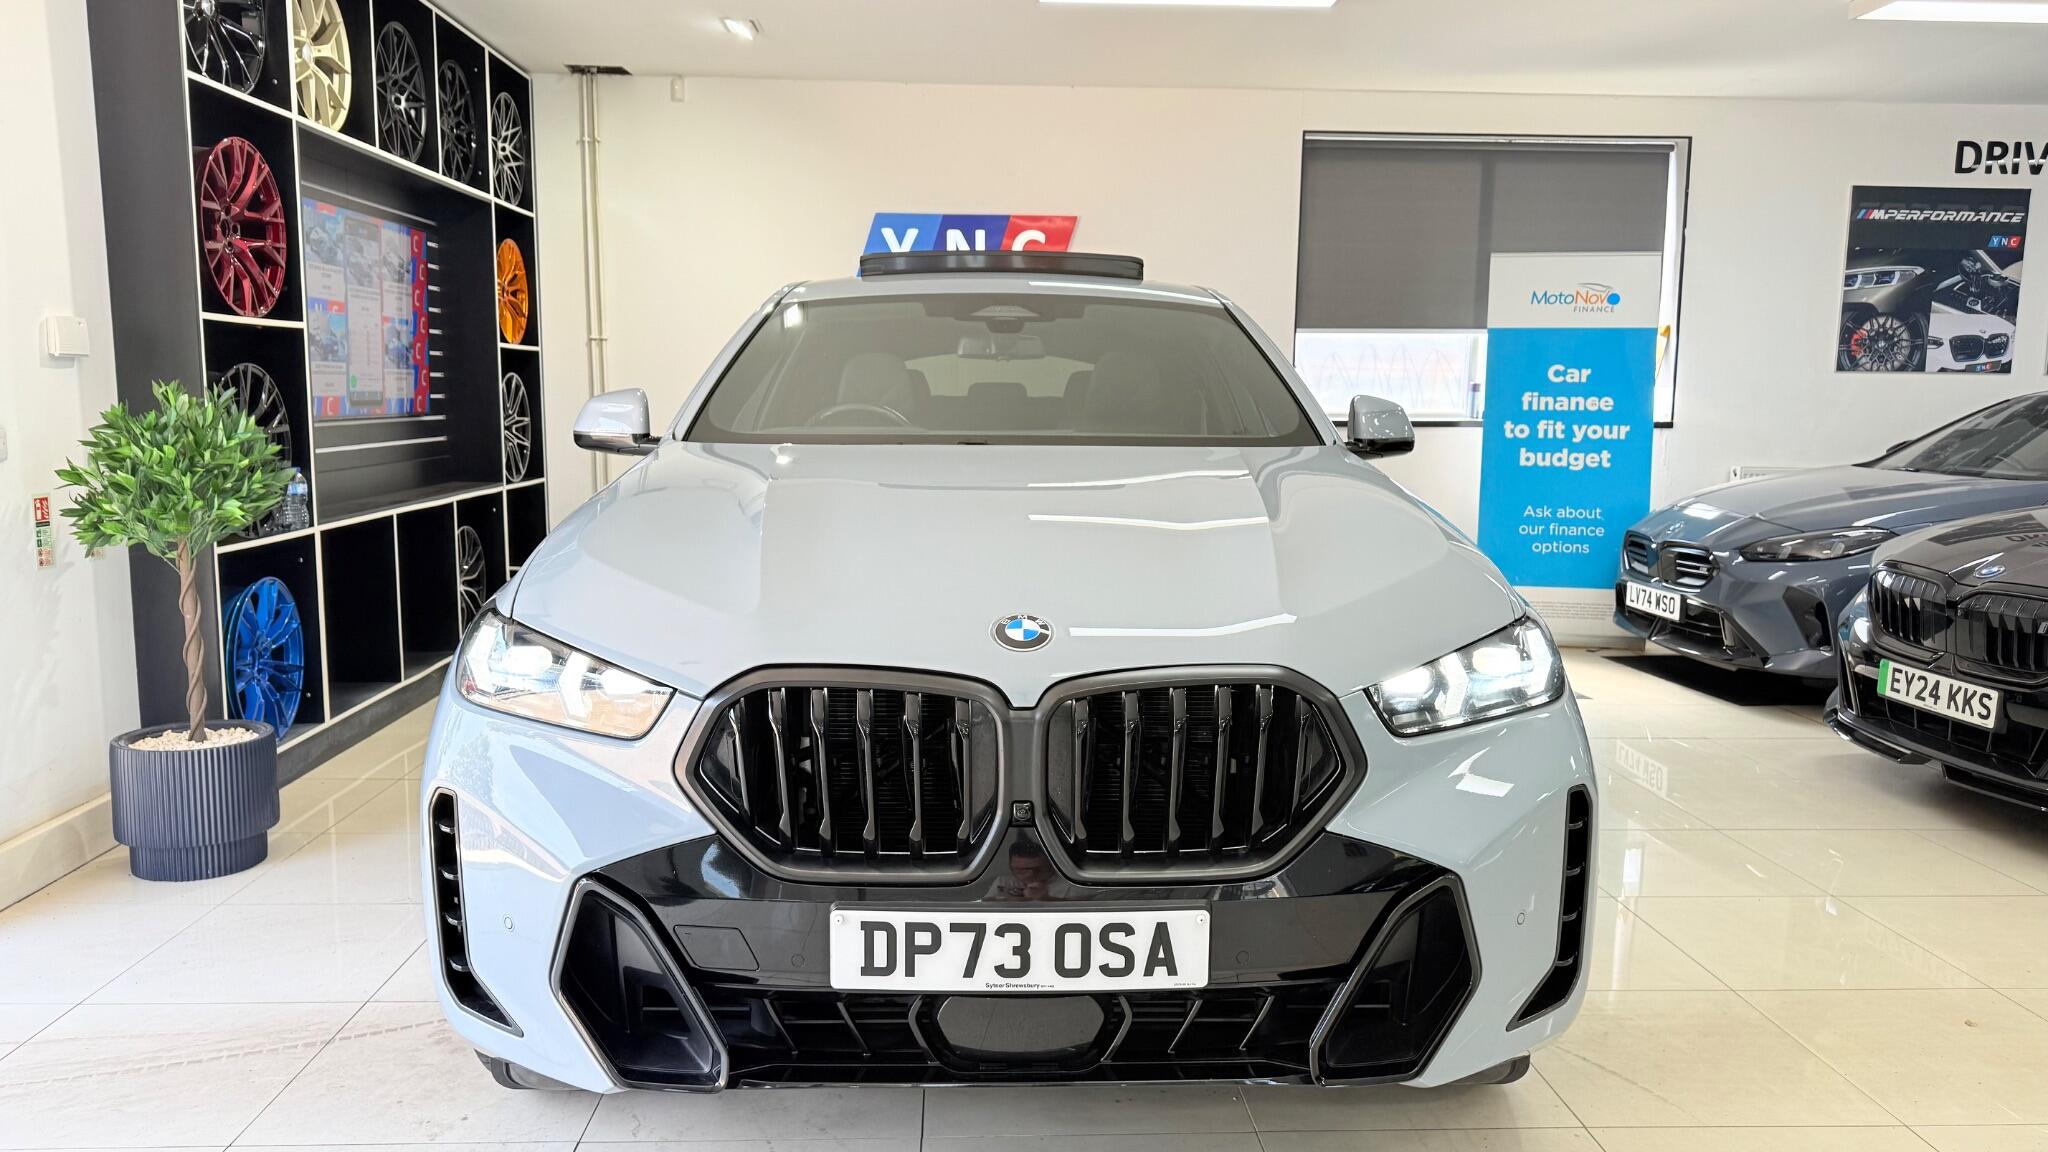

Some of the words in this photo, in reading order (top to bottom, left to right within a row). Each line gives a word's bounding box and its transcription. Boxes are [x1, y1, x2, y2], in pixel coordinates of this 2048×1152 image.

[1954, 140, 2048, 175] DRIV
[881, 227, 1046, 253] YNC
[1991, 236, 2018, 247] YNC
[1547, 364, 1592, 383] Car
[1521, 392, 1615, 412] finance
[1504, 421, 1530, 438] to
[1537, 421, 1565, 439] fit
[1572, 423, 1631, 443] your
[1519, 448, 1612, 471] budget
[1523, 505, 1552, 518] Ask
[1556, 506, 1603, 519] about
[1519, 525, 1544, 535] our
[1549, 523, 1605, 537] finance
[1531, 541, 1590, 555] options
[1629, 585, 1653, 608] LV74
[1654, 592, 1676, 615] WSO
[1889, 666, 1941, 706] EY24
[1946, 683, 1993, 720] KKS
[860, 920, 1031, 979] DP73
[1054, 921, 1179, 978] OSA
